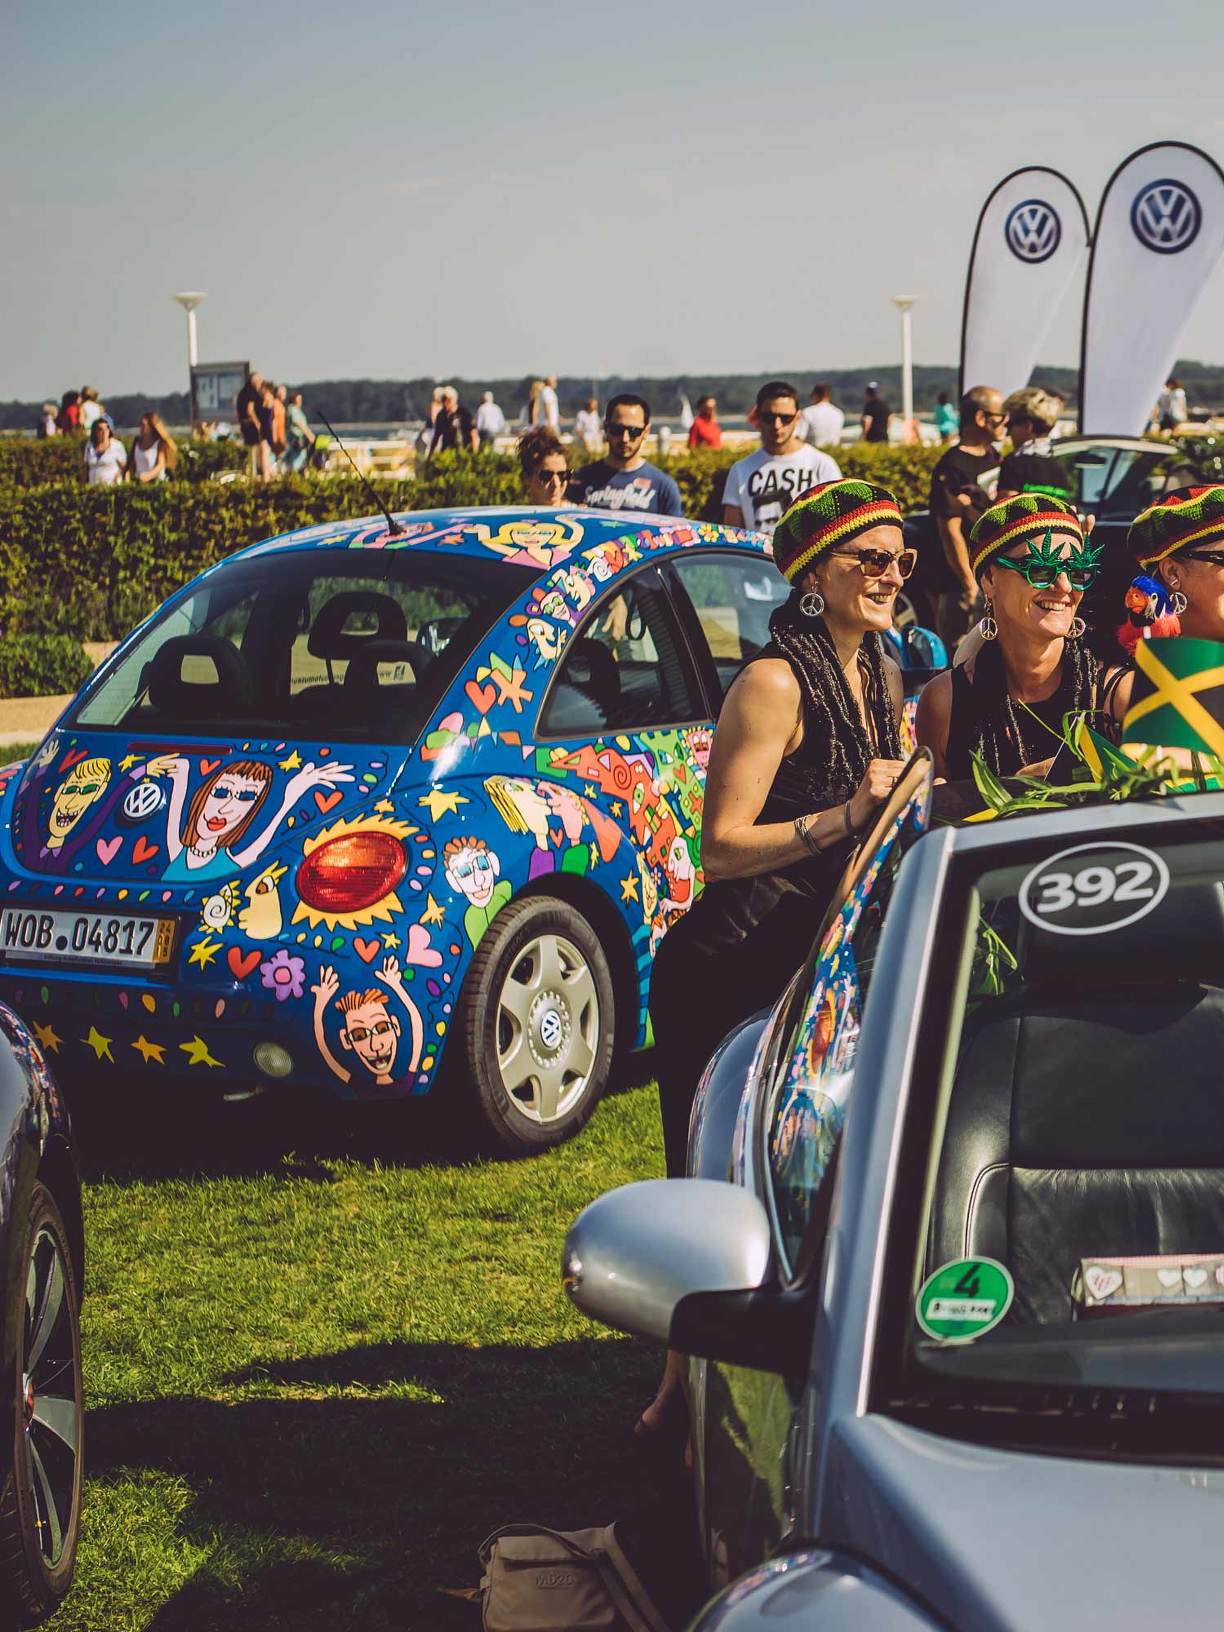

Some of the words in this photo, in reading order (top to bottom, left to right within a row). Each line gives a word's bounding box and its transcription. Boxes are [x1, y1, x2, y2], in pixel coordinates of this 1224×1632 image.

[1009, 204, 1057, 259] VW
[1135, 185, 1198, 248] VW
[750, 468, 813, 496] CASH
[124, 783, 161, 817] VW
[1037, 861, 1154, 913] 392
[72, 917, 155, 955] 04817
[954, 1263, 981, 1298] 4
